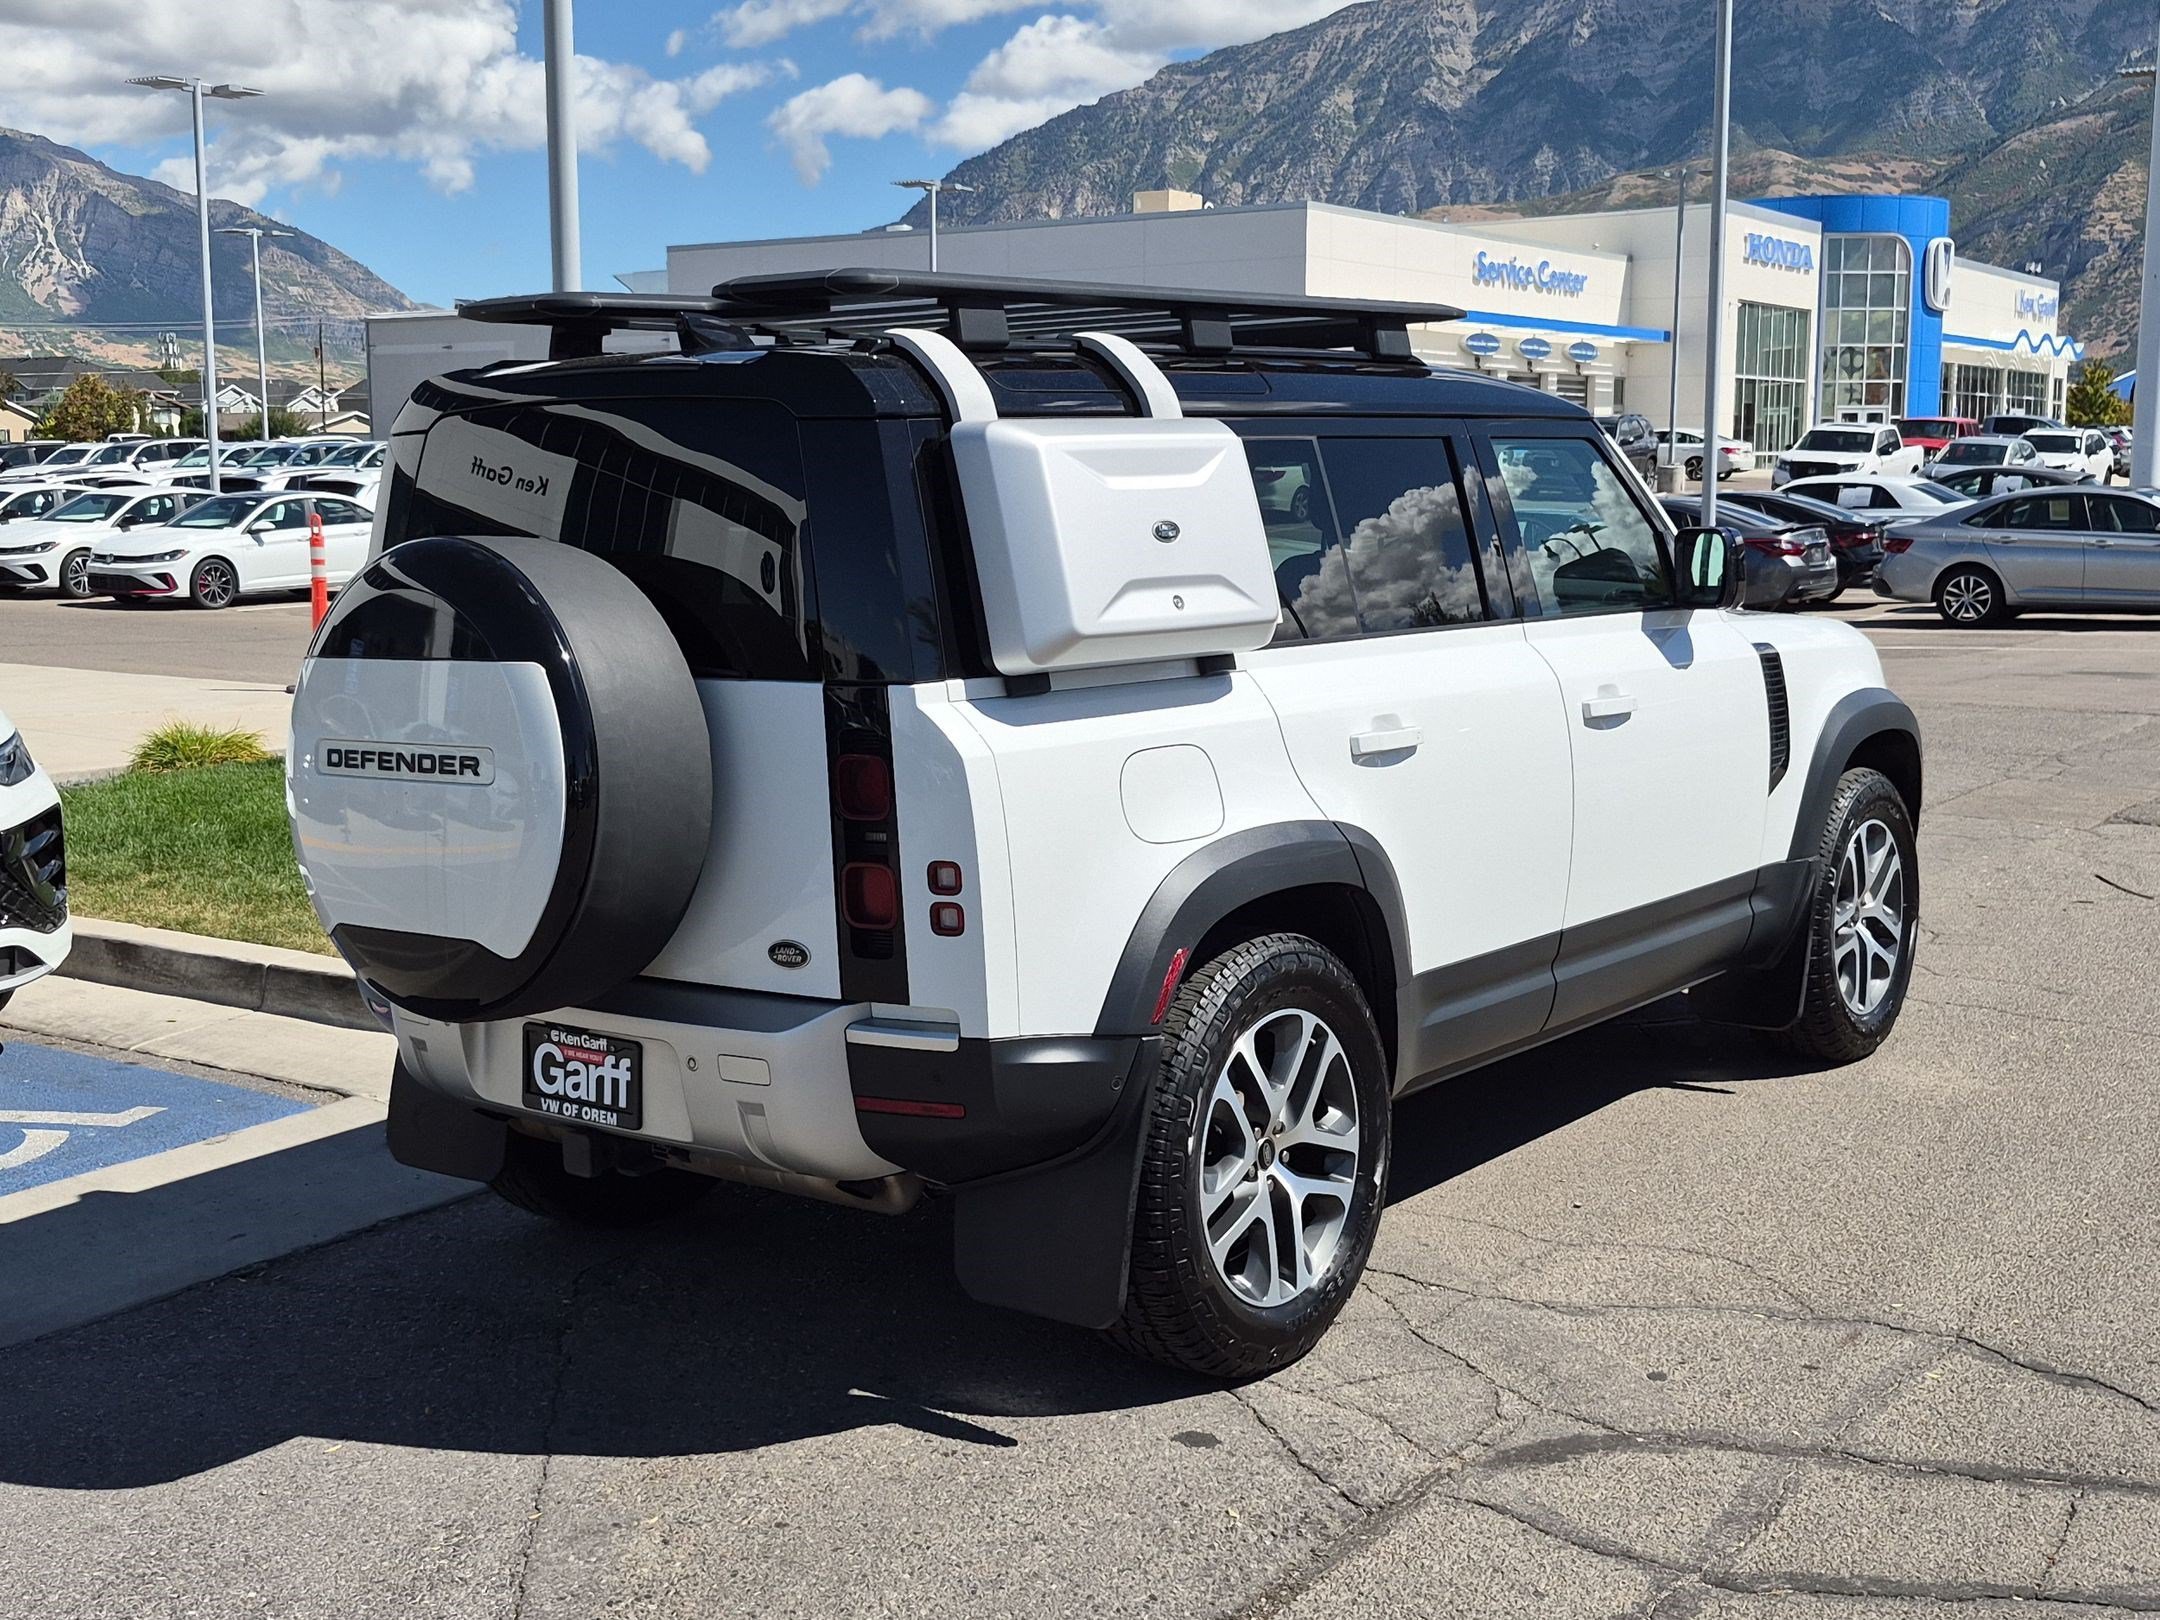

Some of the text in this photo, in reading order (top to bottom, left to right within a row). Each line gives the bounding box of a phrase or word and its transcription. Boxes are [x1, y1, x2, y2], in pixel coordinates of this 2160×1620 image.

[1747, 232, 1815, 271] HONDA
[1477, 250, 1588, 293] Service Center
[326, 748, 481, 777] DEFENDER
[775, 946, 796, 955] LAND
[777, 954, 802, 963] ROVER
[559, 1030, 608, 1052] Ken Garff
[533, 1042, 632, 1109] Garff
[540, 1097, 618, 1126] VW OF OREM
